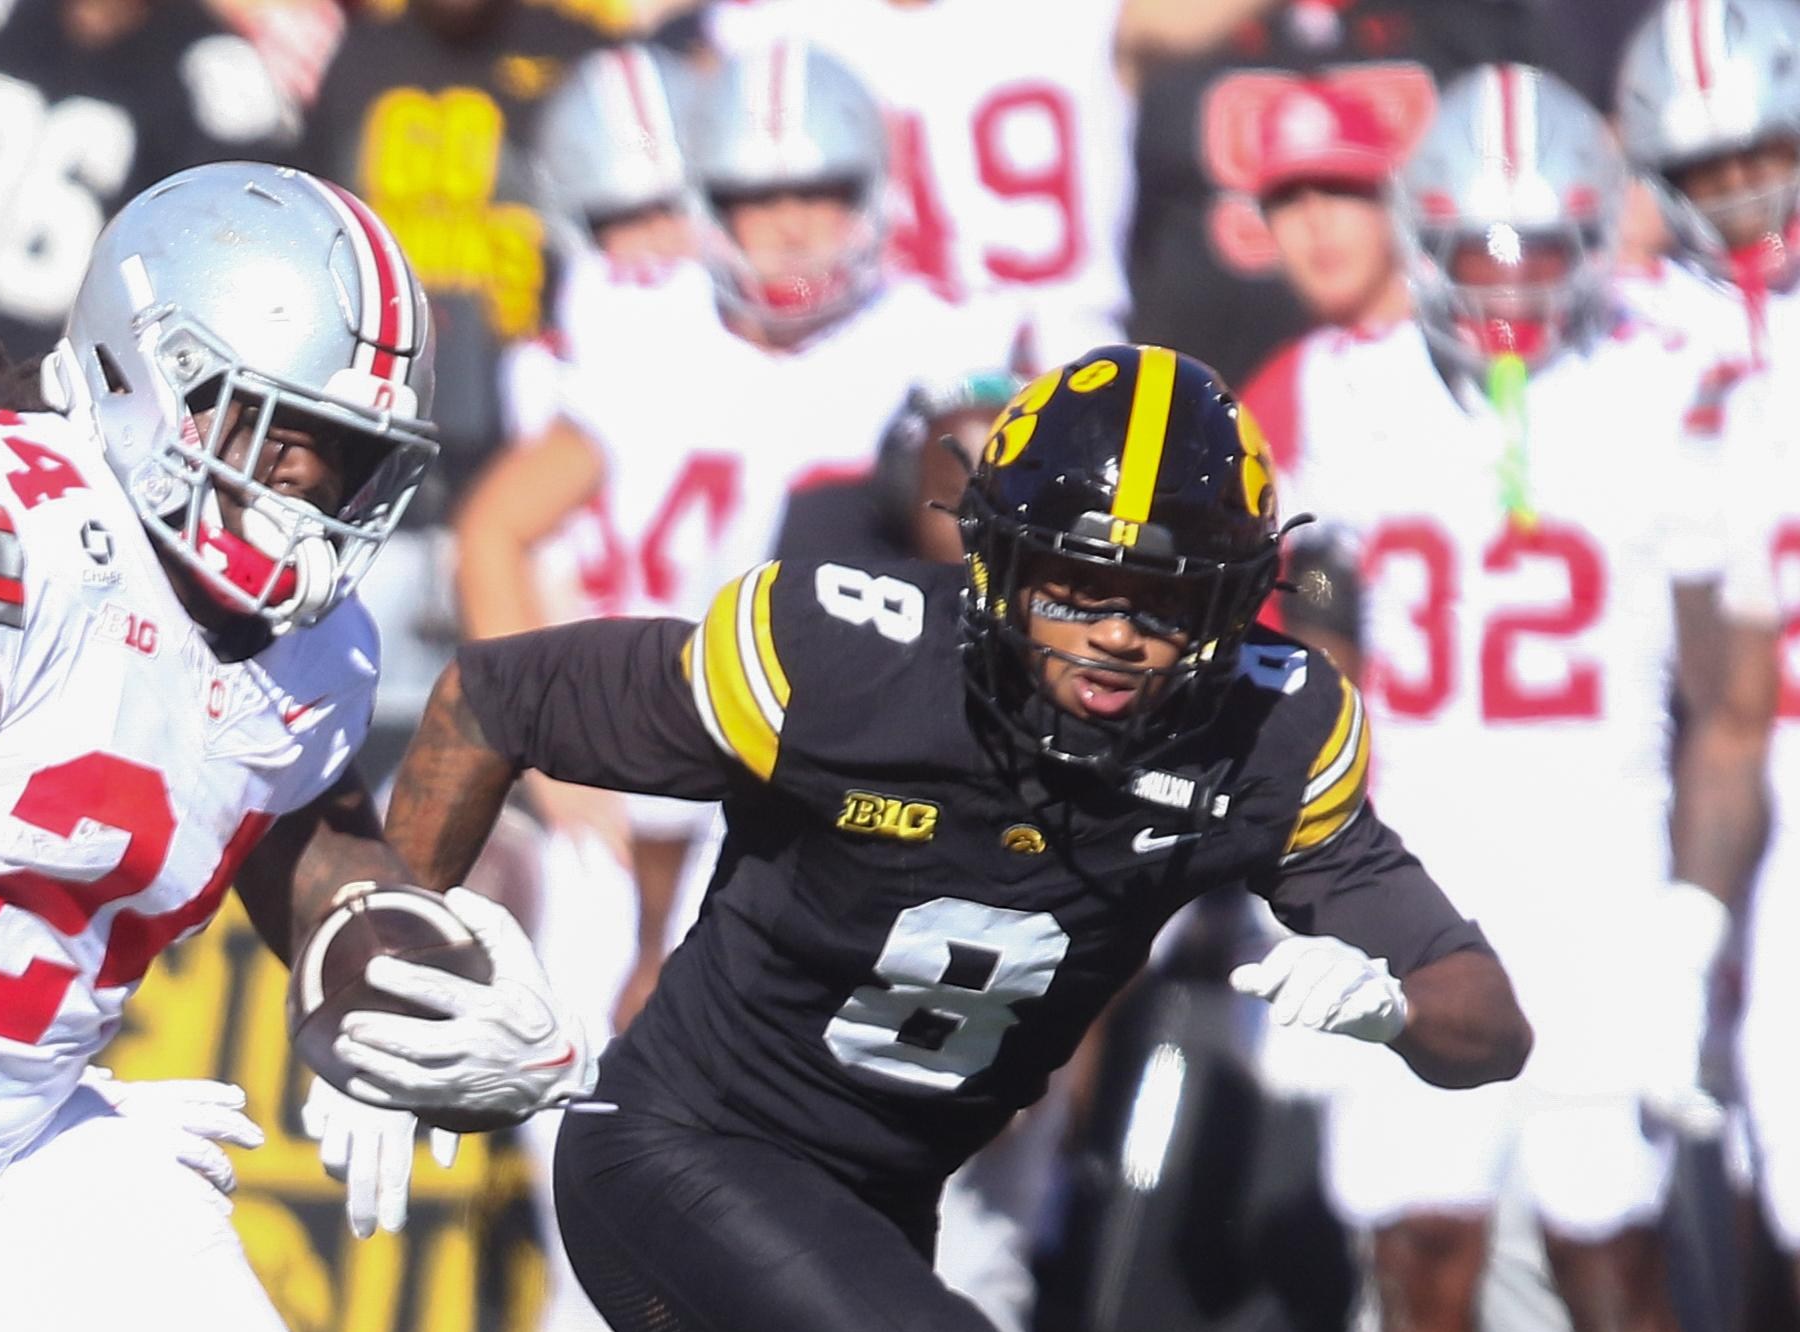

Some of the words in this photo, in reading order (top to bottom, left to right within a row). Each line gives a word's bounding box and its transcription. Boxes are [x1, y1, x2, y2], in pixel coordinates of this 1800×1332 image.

[815, 561, 925, 643] 8
[1357, 512, 1608, 726] 32
[821, 896, 1071, 1091] 8
